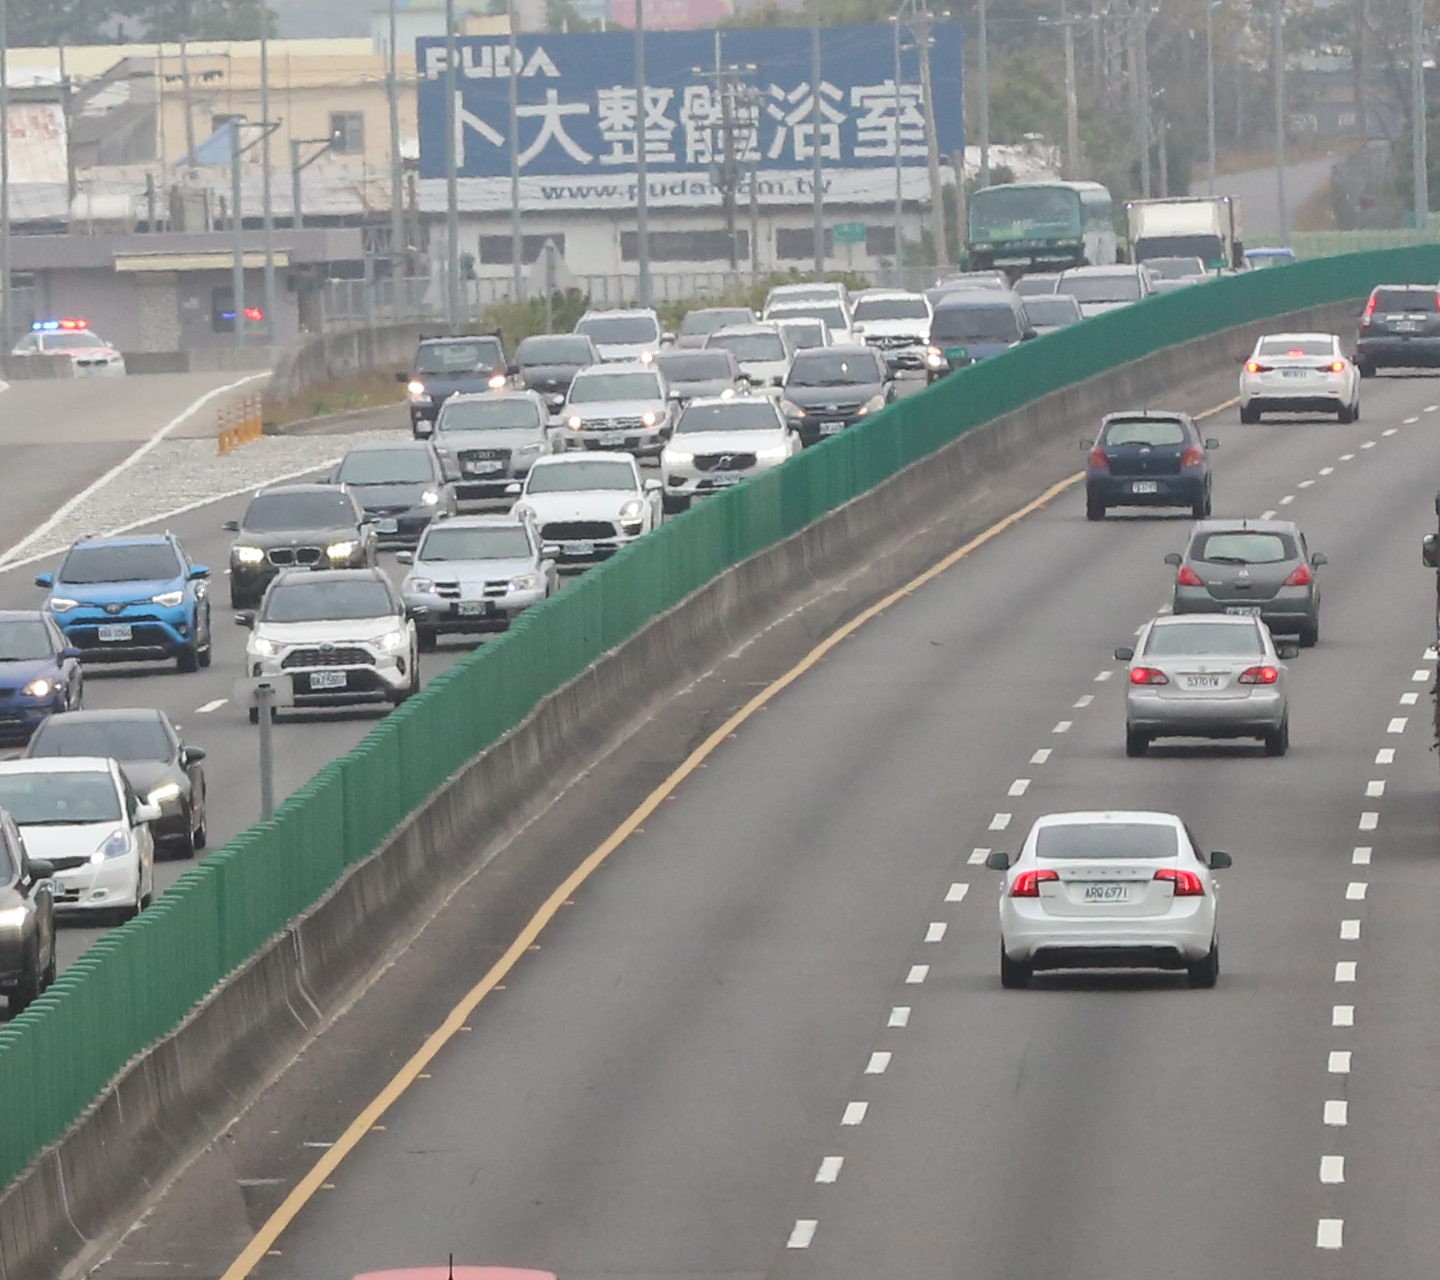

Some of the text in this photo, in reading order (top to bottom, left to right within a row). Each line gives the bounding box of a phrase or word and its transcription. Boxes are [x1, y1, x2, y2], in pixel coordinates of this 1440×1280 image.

[424, 45, 562, 81] PUDA
[453, 79, 931, 168] 卜大整體浴室
